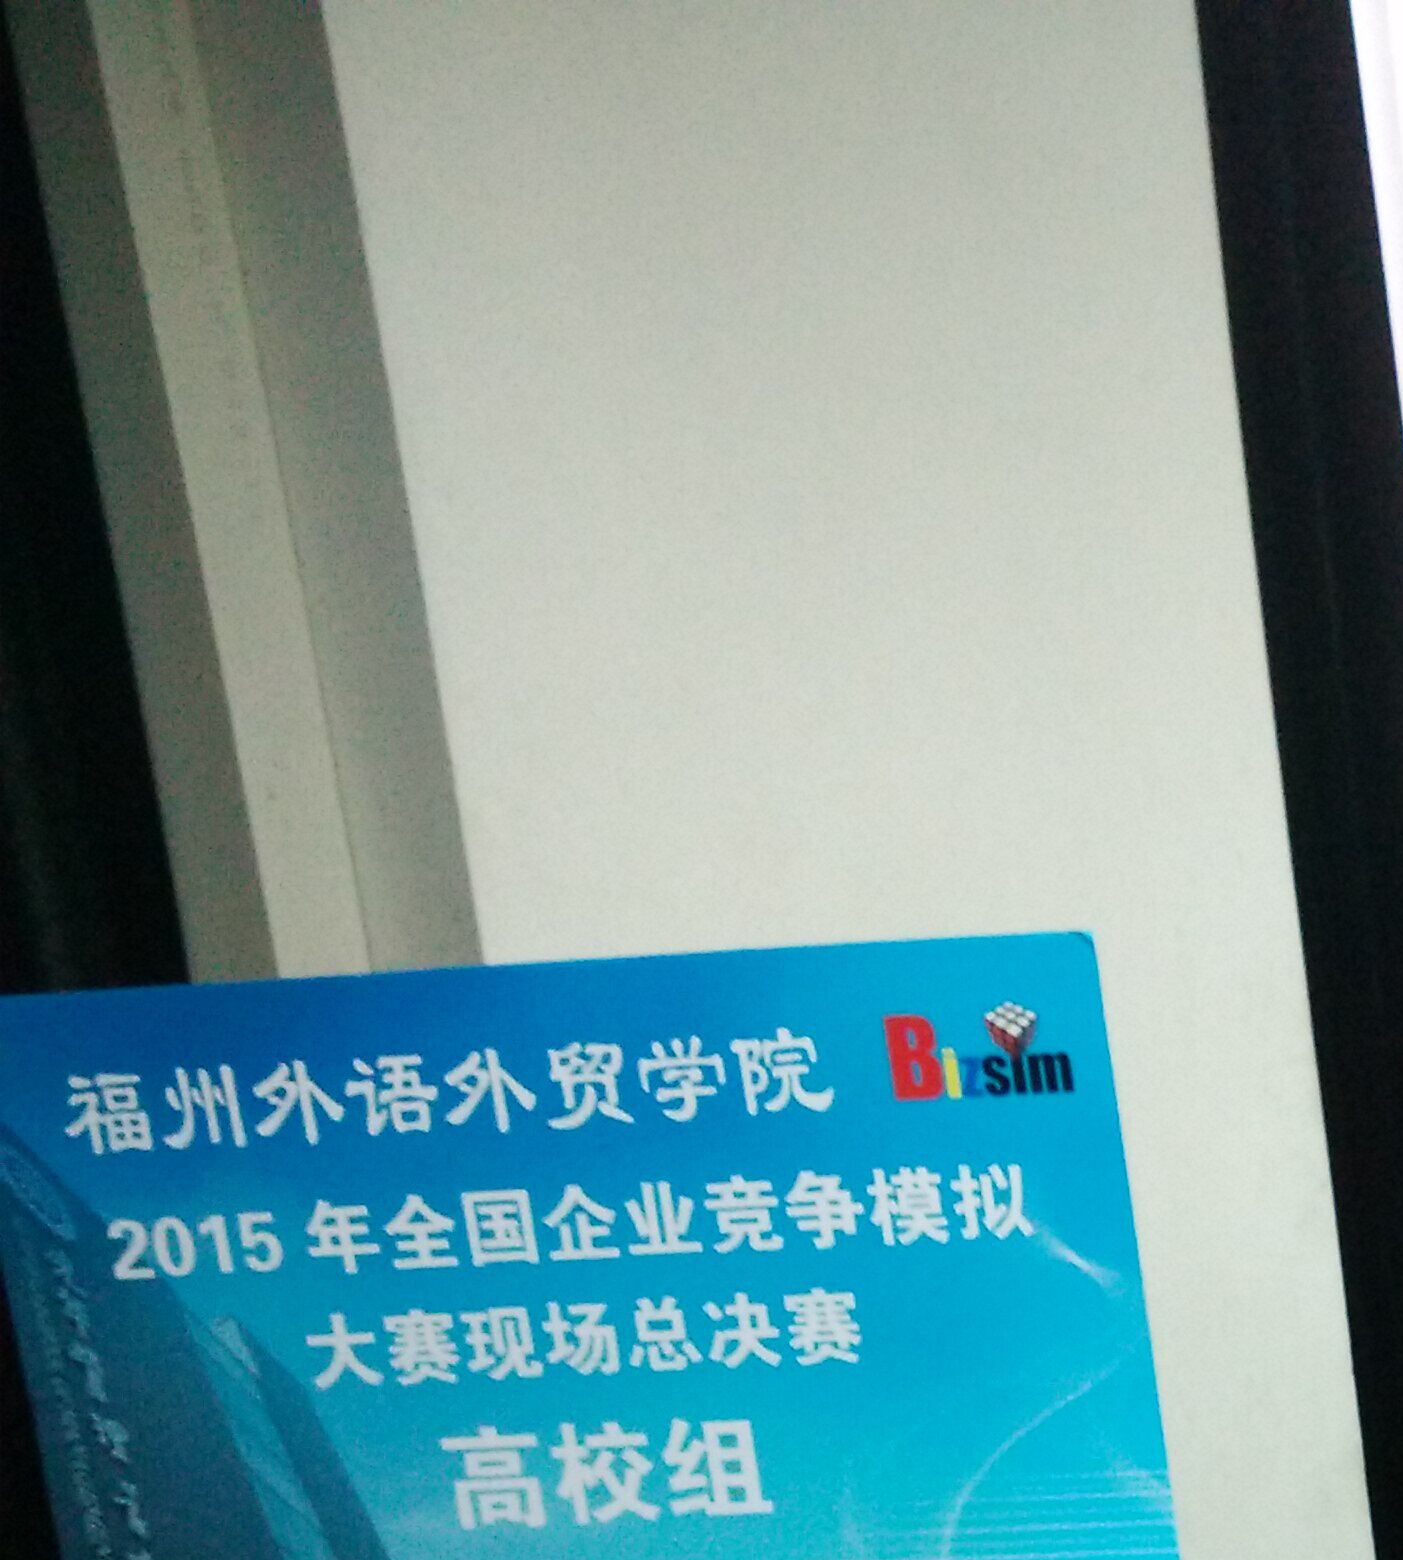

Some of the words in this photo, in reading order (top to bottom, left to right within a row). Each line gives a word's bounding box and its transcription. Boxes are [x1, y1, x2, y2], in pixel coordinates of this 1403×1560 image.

[65, 1027, 834, 1156] 福州外语外贸学院
[305, 1288, 862, 1390] 大赛现场总决赛
[439, 1417, 775, 1530] 高校组
